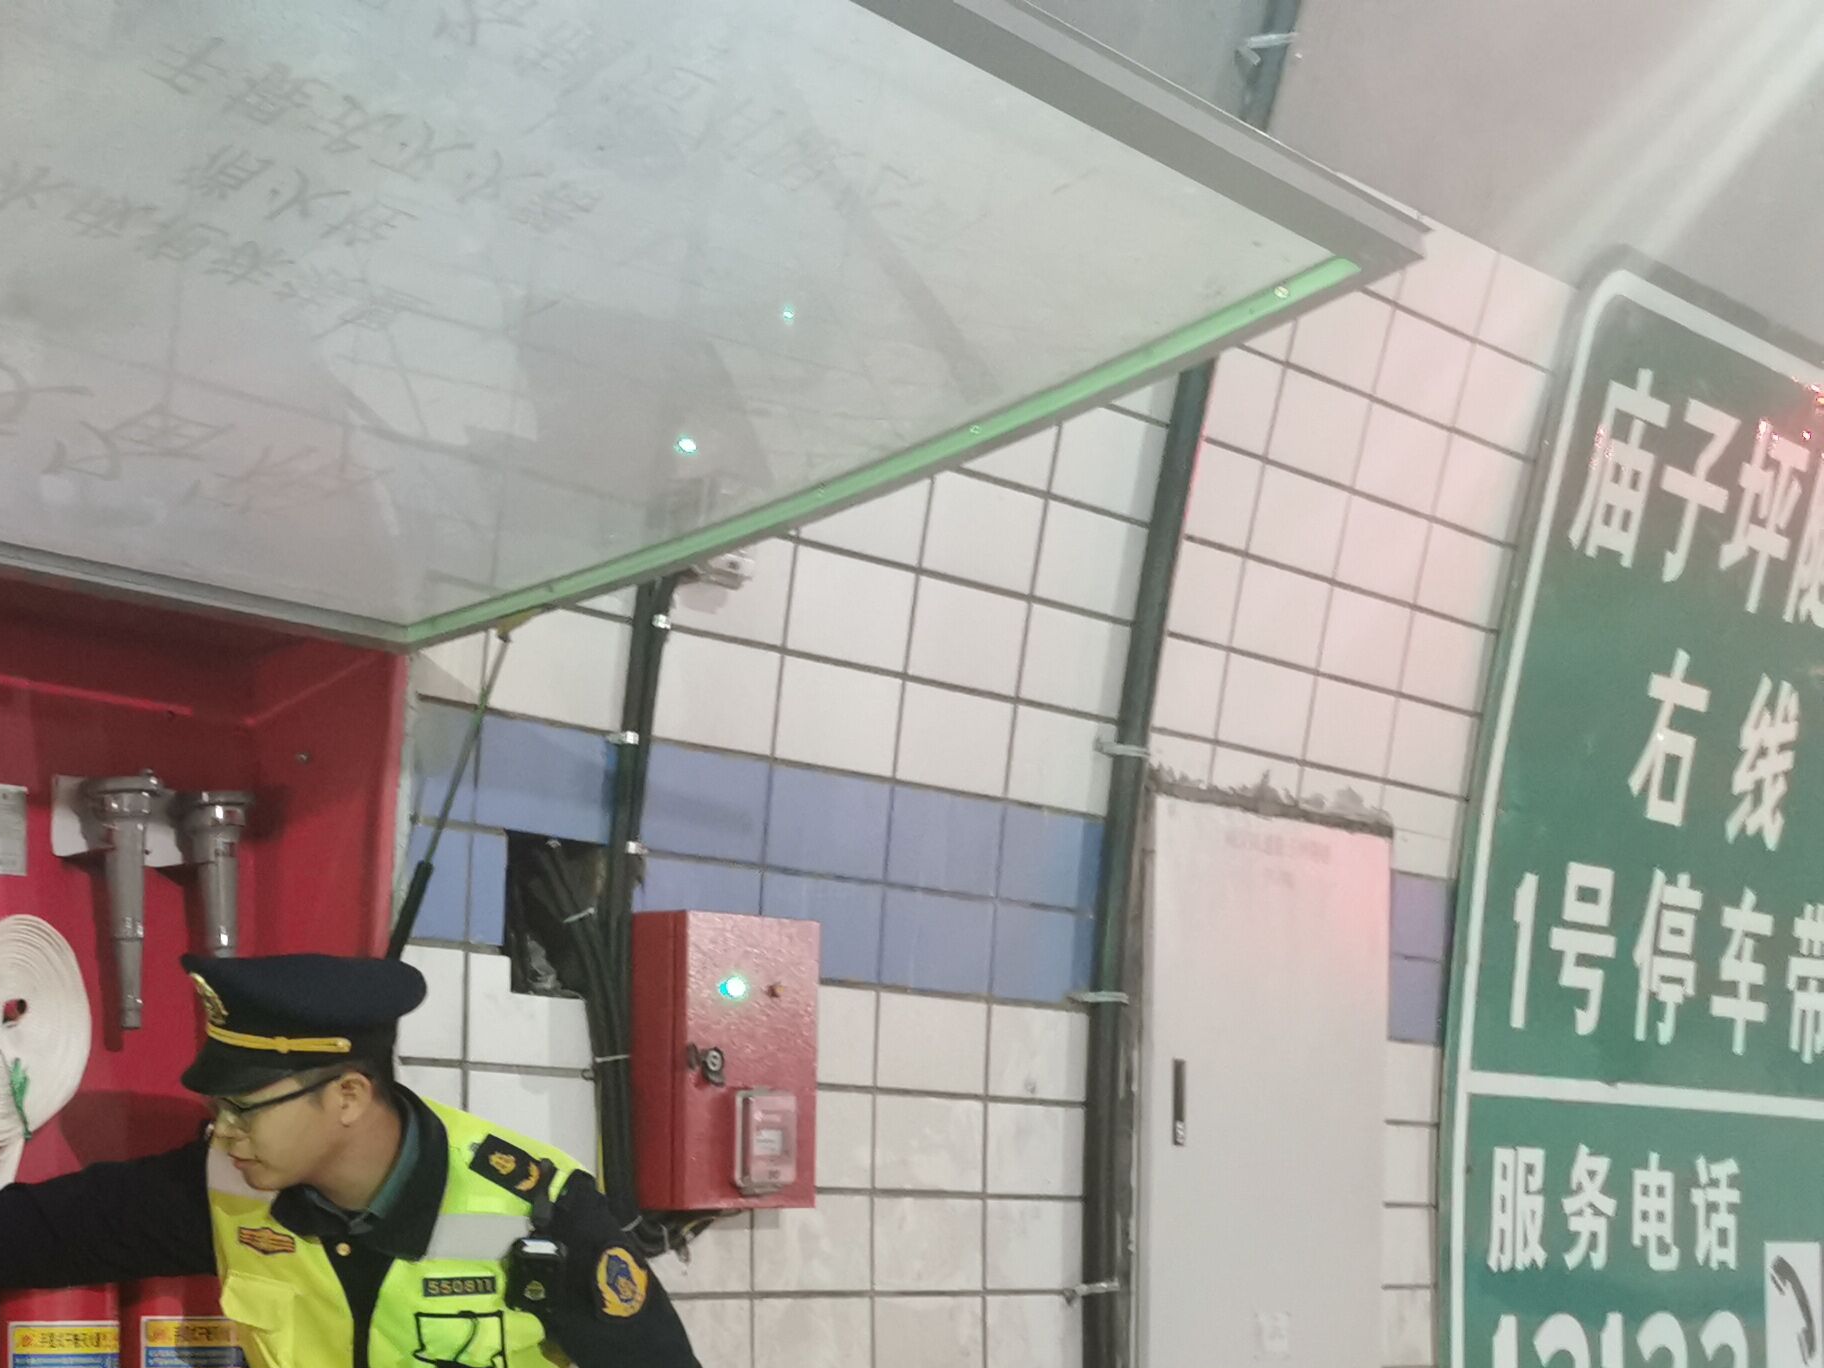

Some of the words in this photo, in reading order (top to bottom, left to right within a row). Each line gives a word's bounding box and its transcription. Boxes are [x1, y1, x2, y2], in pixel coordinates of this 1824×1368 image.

[1627, 648, 1798, 850] 右线
[1487, 1142, 1742, 1272] 服务电话
